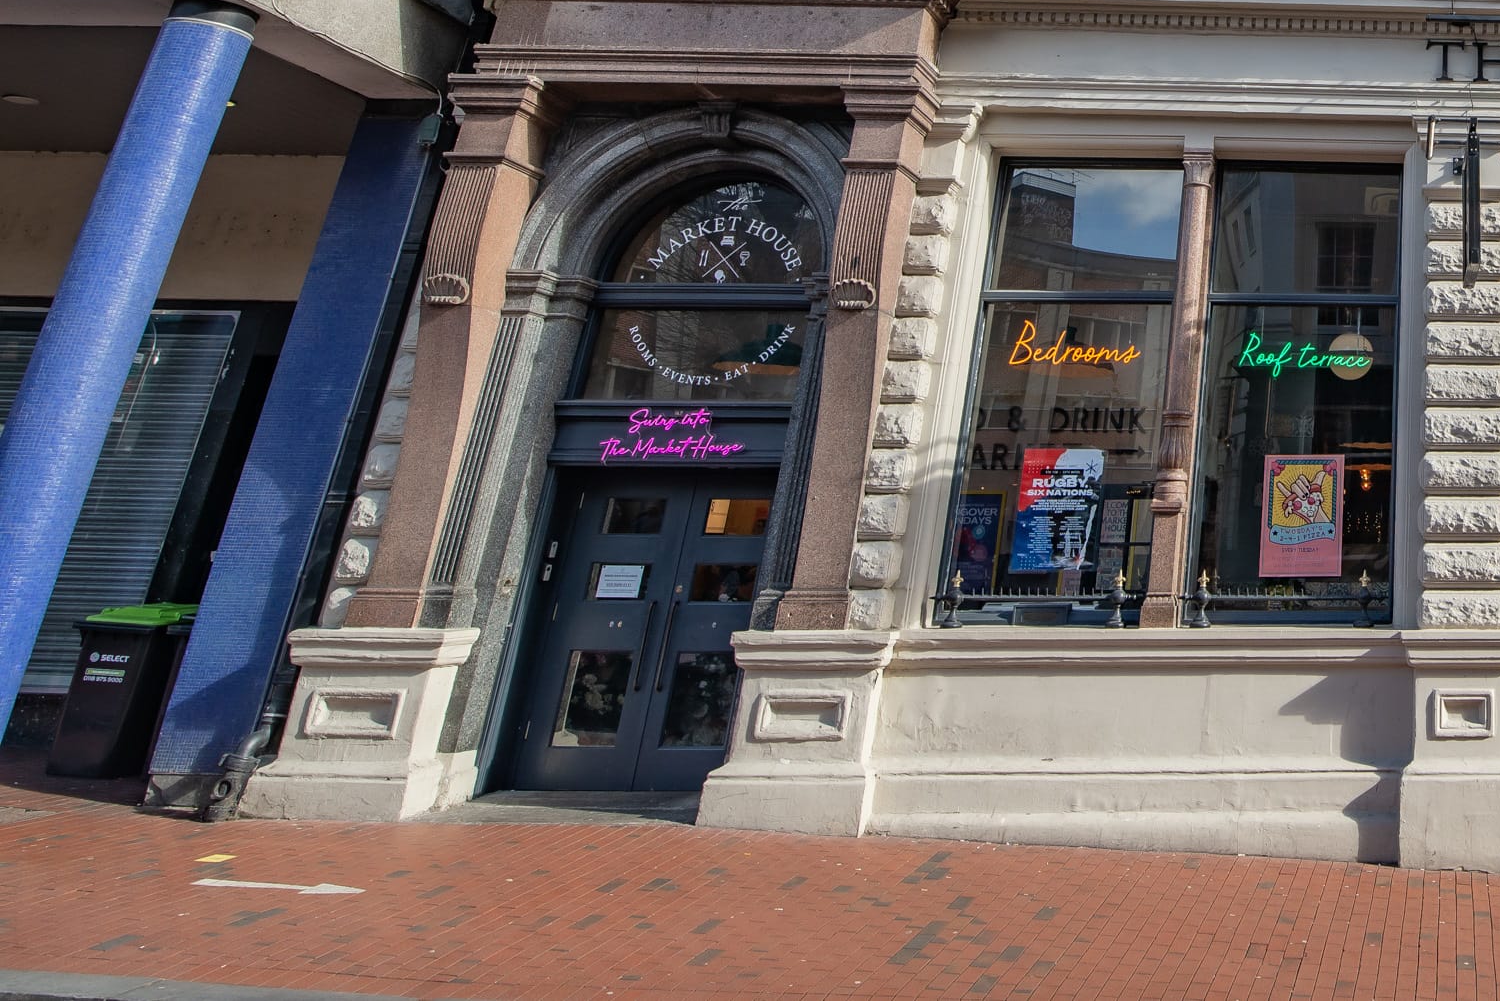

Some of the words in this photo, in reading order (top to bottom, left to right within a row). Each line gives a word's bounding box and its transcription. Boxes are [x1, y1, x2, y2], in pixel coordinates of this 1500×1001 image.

[717, 196, 763, 212] The
[647, 216, 741, 270] MARKET
[745, 219, 802, 271] HOUSE
[628, 325, 658, 367] ROOMS
[661, 367, 711, 386] EVENTS
[725, 362, 749, 381] EAT
[759, 324, 796, 362] DRINK
[1008, 319, 1142, 365] Bedrooms
[1238, 332, 1293, 377] Roof
[1298, 342, 1371, 368] terrace
[628, 408, 679, 433] Swing
[1050, 406, 1147, 435] DRINK
[600, 437, 630, 461] The
[631, 436, 699, 460] Market
[691, 435, 745, 460] House
[1303, 531, 1326, 540] PIZZA
[100, 654, 130, 663] SELECT
